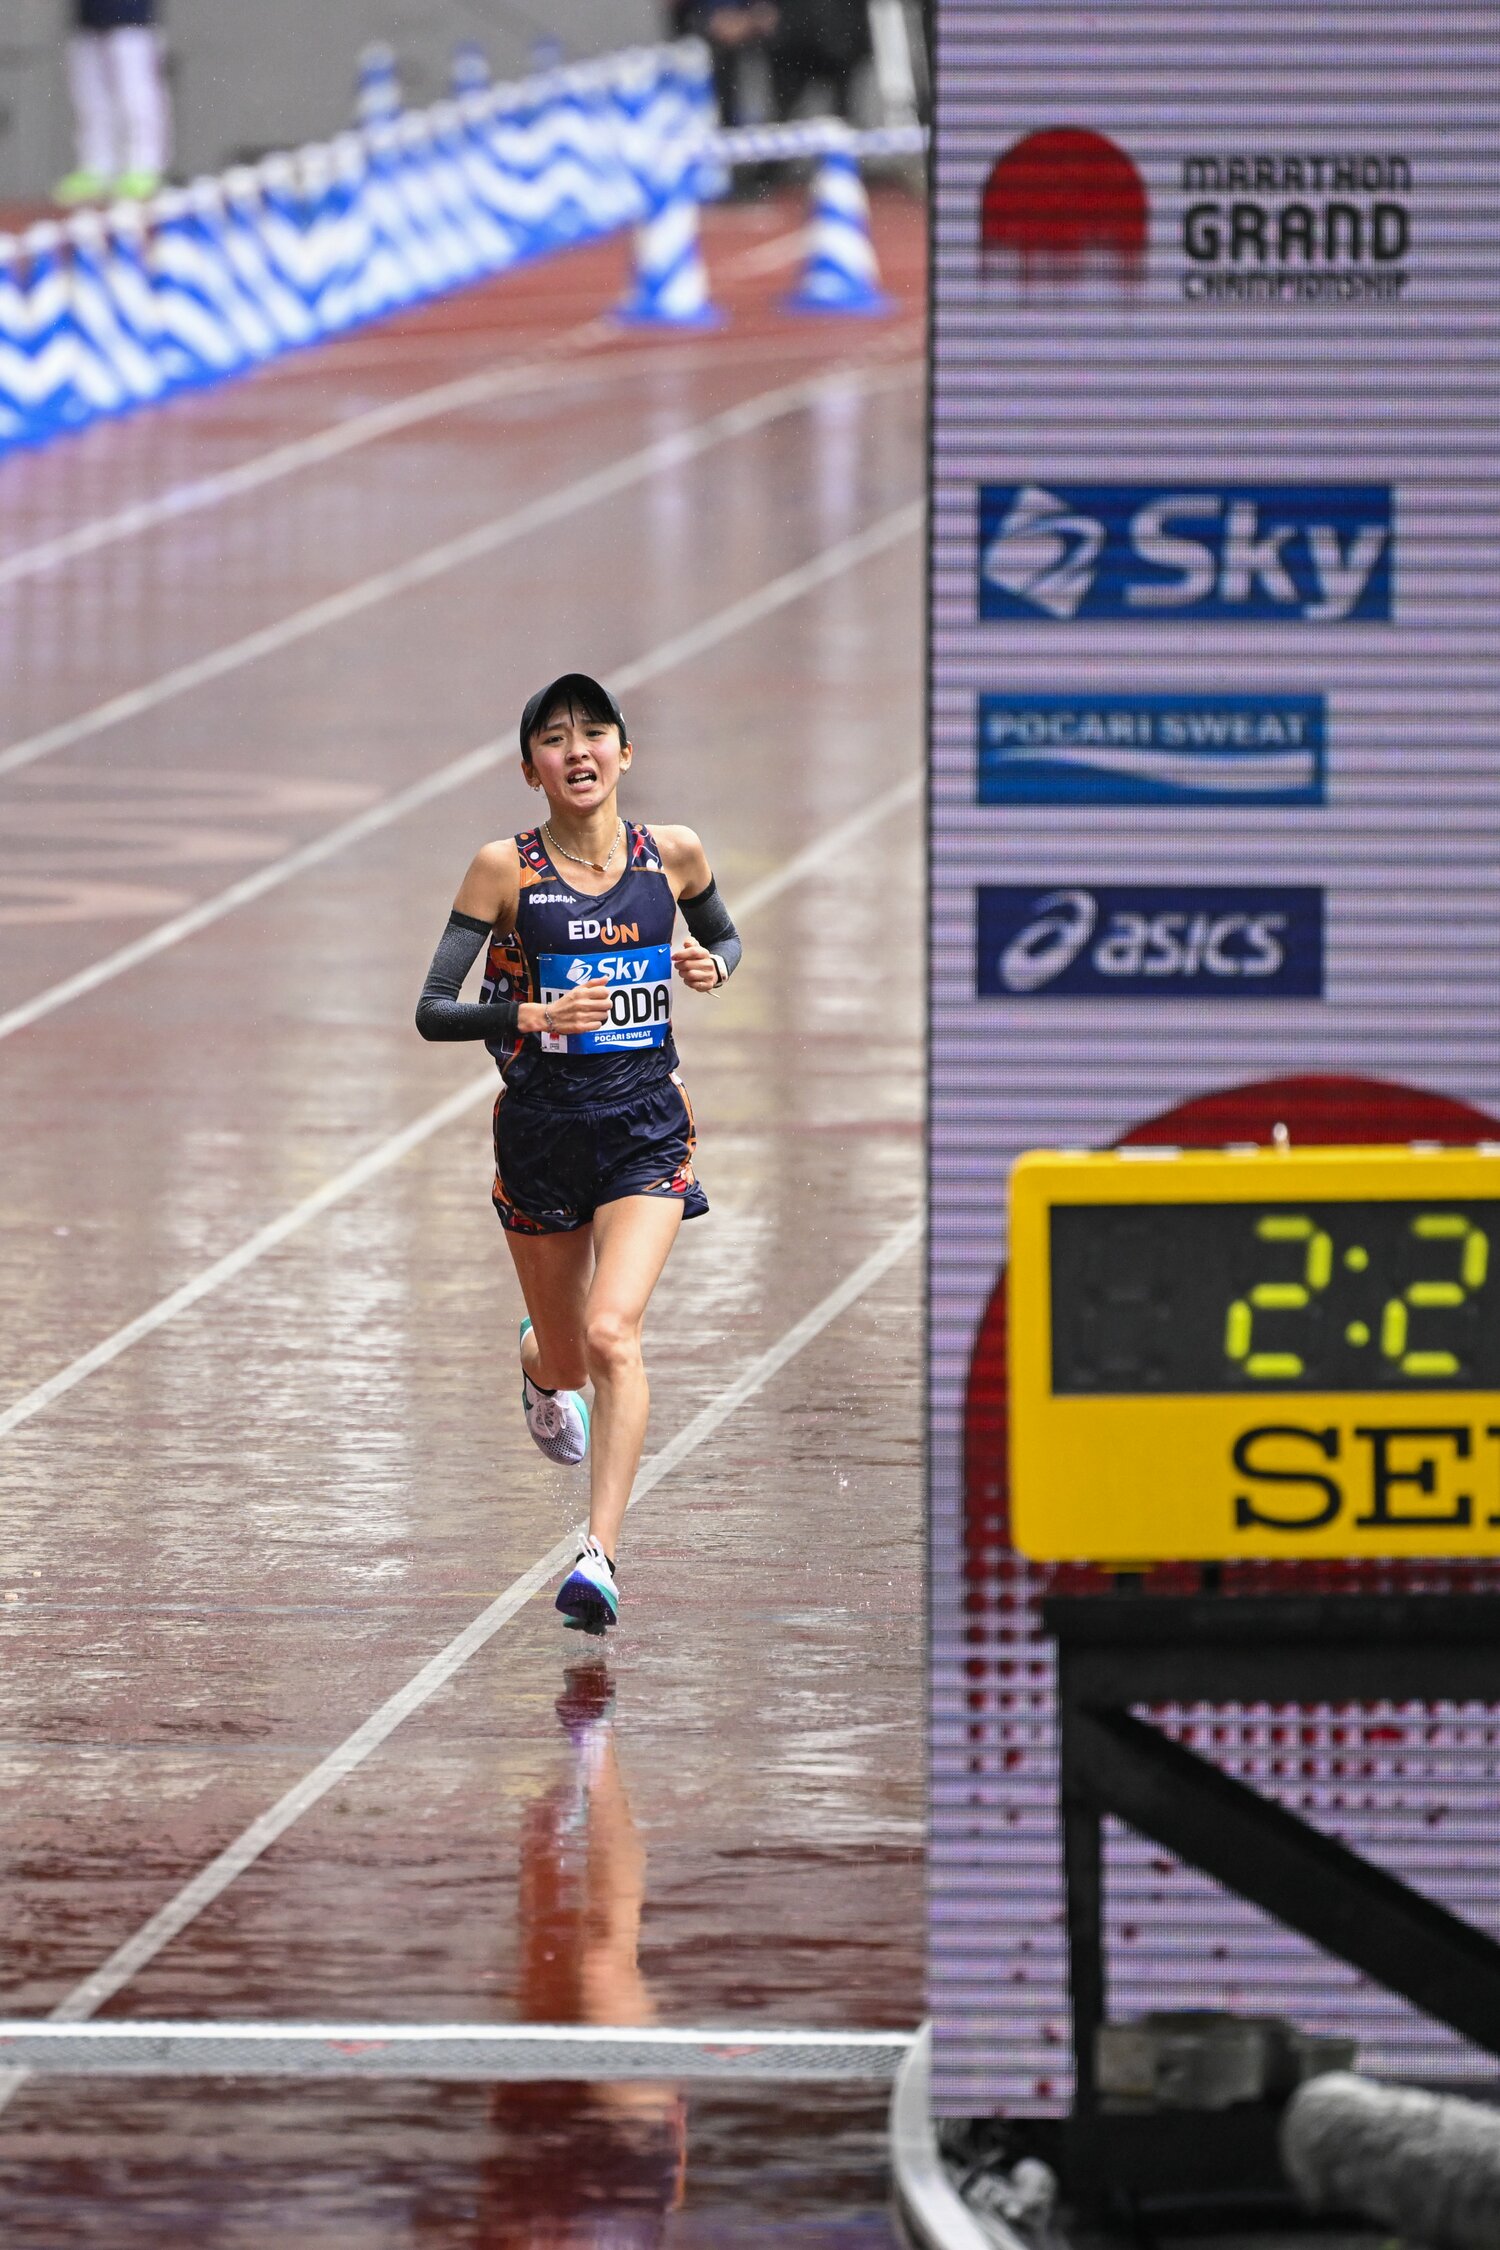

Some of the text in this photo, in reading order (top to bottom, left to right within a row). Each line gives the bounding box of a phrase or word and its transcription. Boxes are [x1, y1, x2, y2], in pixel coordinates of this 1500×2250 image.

[1184, 156, 1410, 191] MARATHON
[1184, 204, 1408, 260] GRAND
[1122, 496, 1390, 619] Sky
[986, 713, 1307, 745] POCARI SWEAT
[568, 917, 640, 946] EDION
[597, 957, 650, 982] Sky
[546, 984, 670, 1027] ODA
[594, 1033, 625, 1043] POCARI
[626, 1030, 652, 1040] SWEAT
